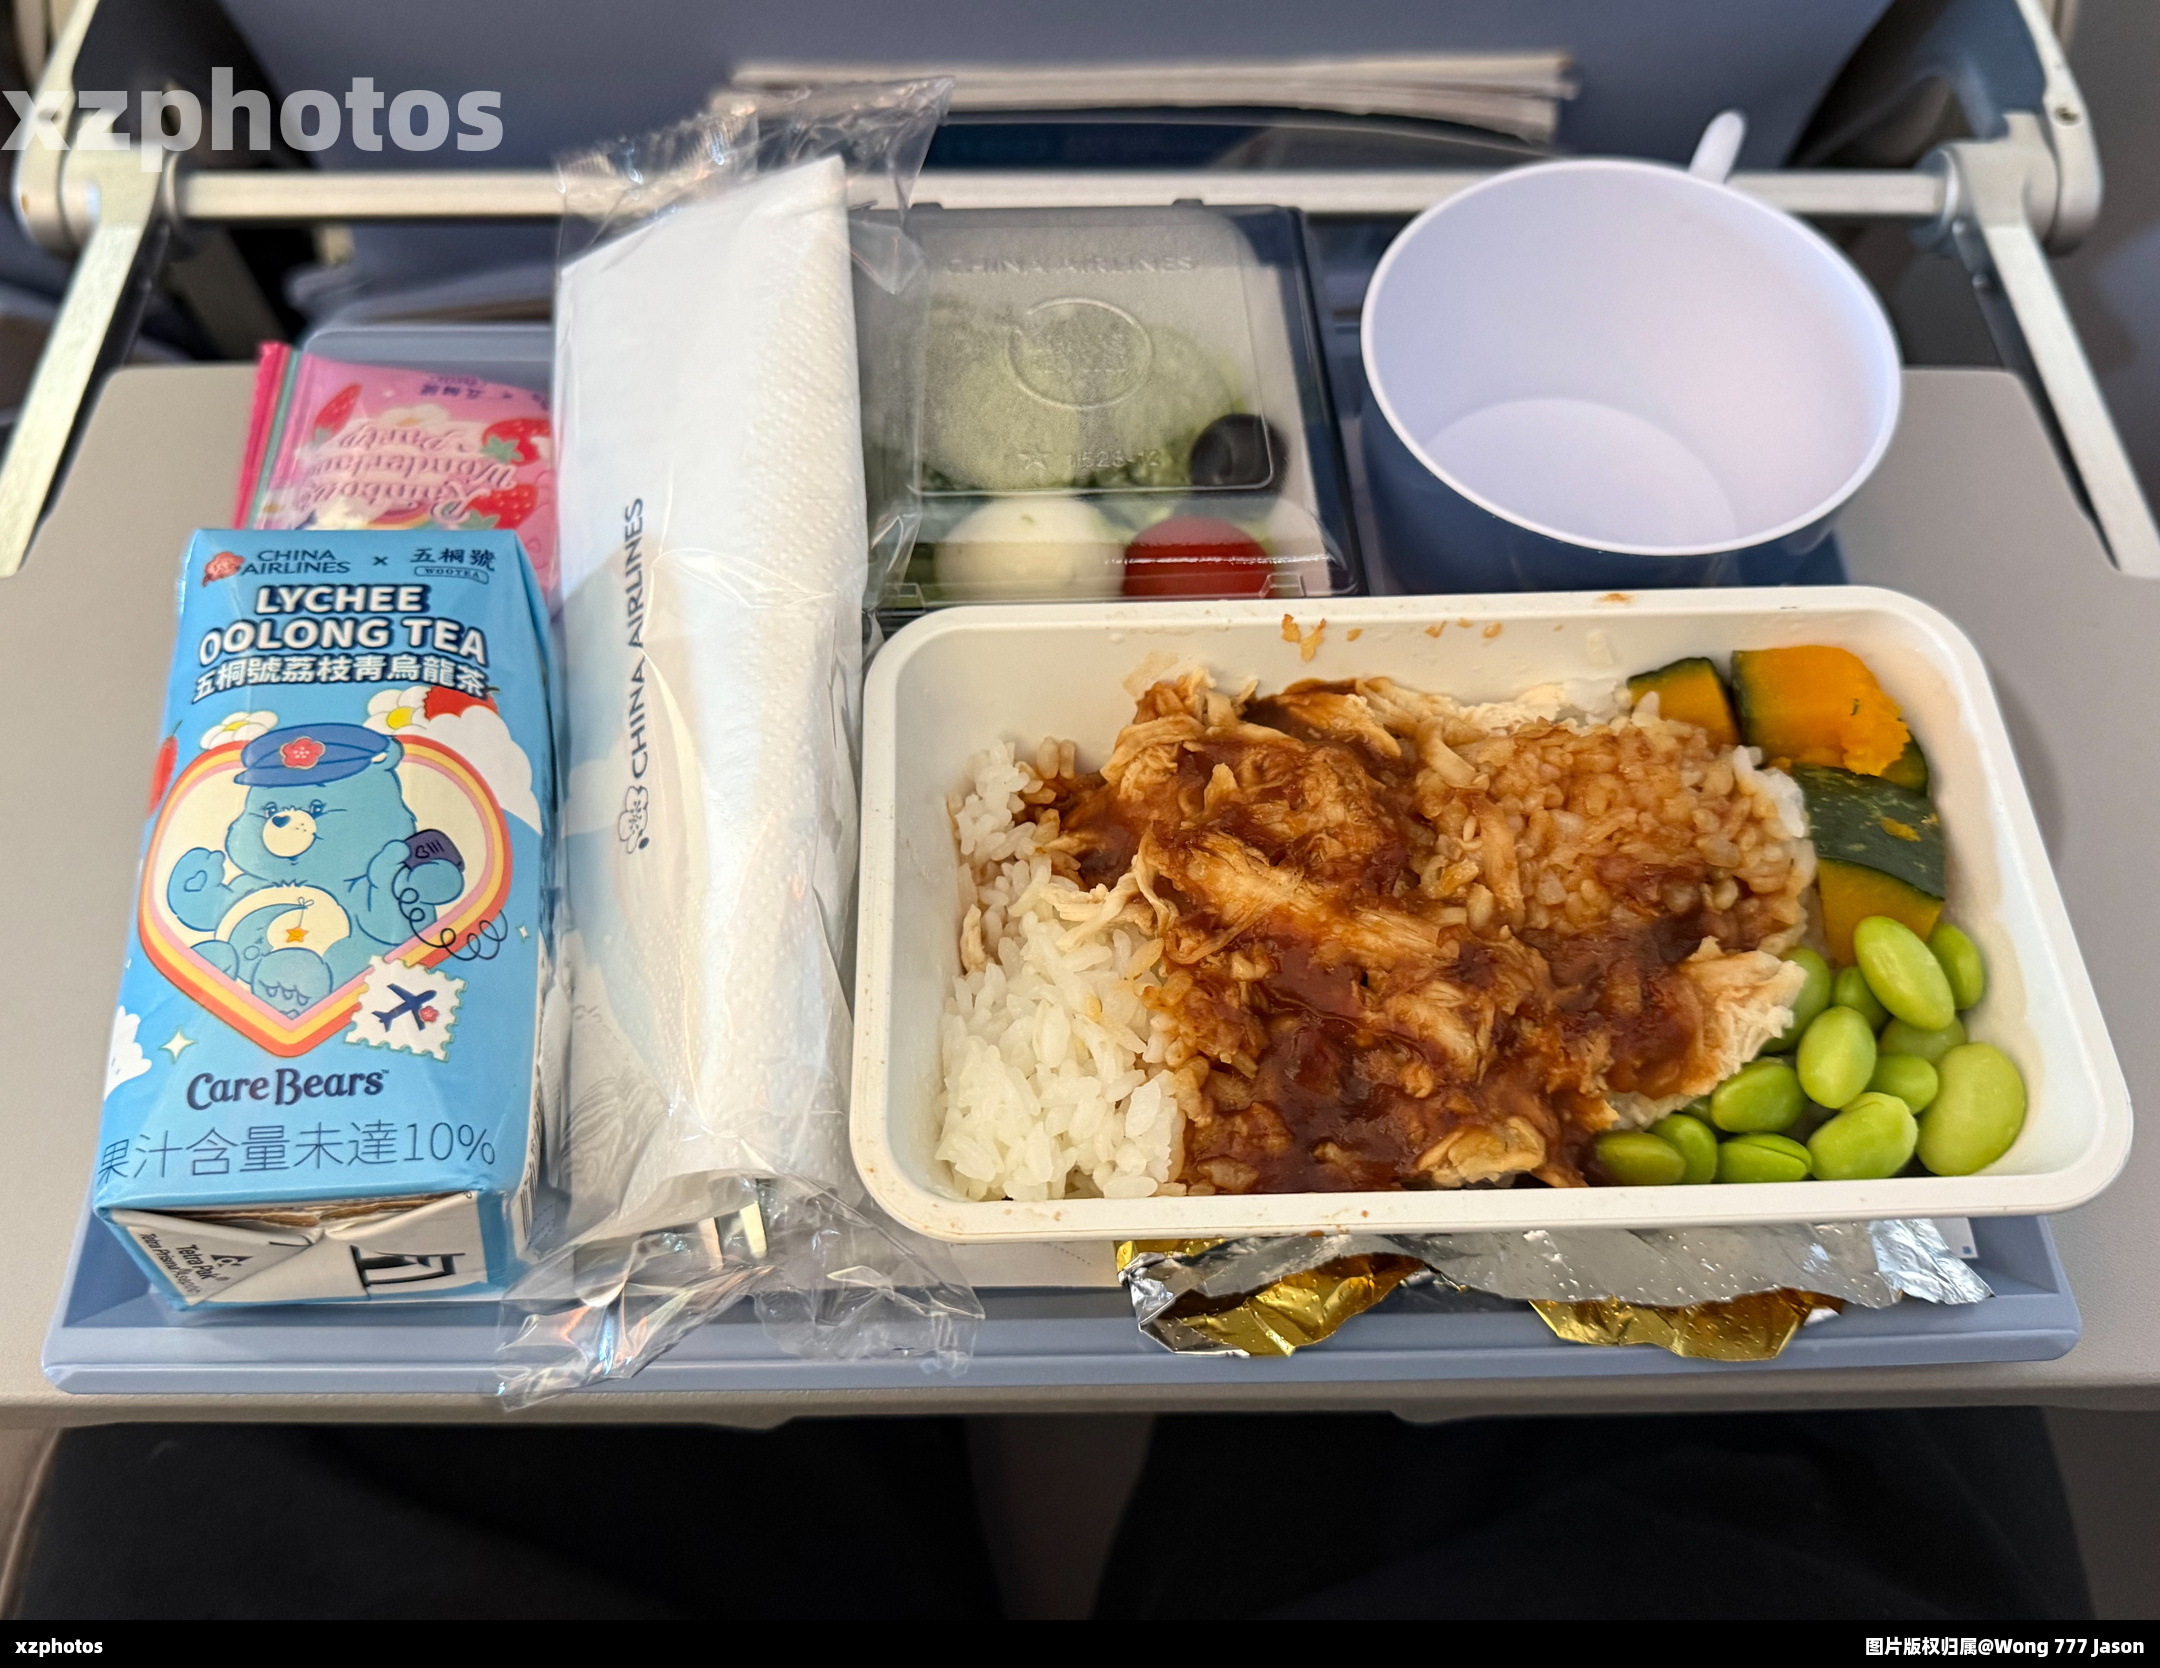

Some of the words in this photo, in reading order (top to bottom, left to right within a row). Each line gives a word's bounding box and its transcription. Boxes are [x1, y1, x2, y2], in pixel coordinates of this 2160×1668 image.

[240, 561, 351, 575] AIRLINES
[256, 549, 336, 561] CHINA
[624, 497, 645, 649] AIRLINES
[255, 584, 430, 615] LYCHEE
[199, 617, 391, 667] OOLONG
[402, 617, 489, 668] TEA
[192, 653, 489, 704] 五桐號荔枝青烏龍茶
[630, 656, 650, 779] CHINA
[187, 1072, 270, 1111] Care
[97, 1118, 496, 1185] 果汁含量未達10%
[176, 1244, 204, 1267] Tetra
